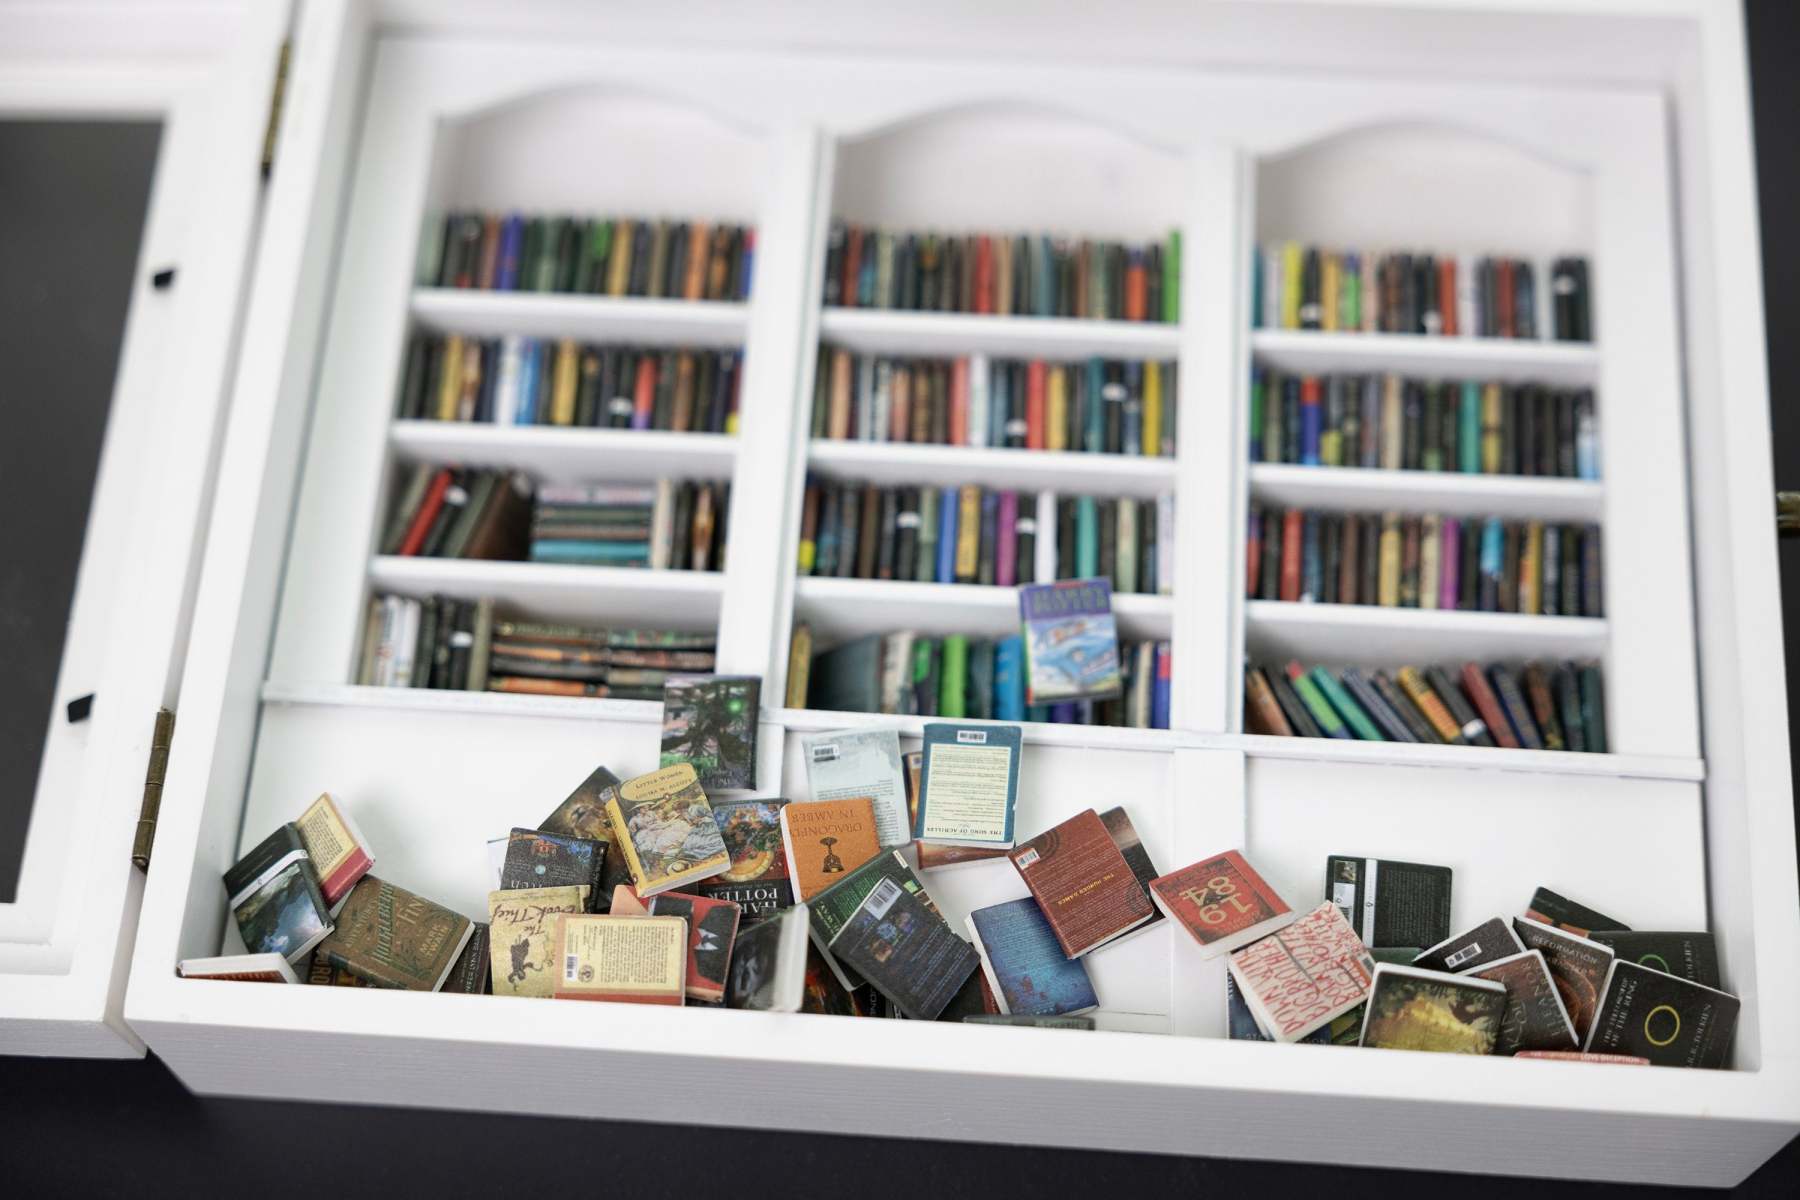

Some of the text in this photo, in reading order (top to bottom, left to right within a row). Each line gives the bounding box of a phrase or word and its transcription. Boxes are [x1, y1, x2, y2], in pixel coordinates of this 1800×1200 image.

[791, 809, 833, 823] AMBER
[1056, 871, 1114, 905] THE HUNGER GAMES
[490, 904, 534, 926] Thief
[418, 922, 441, 954] MARK
[424, 924, 449, 960] TWAIN
[523, 925, 544, 936] The
